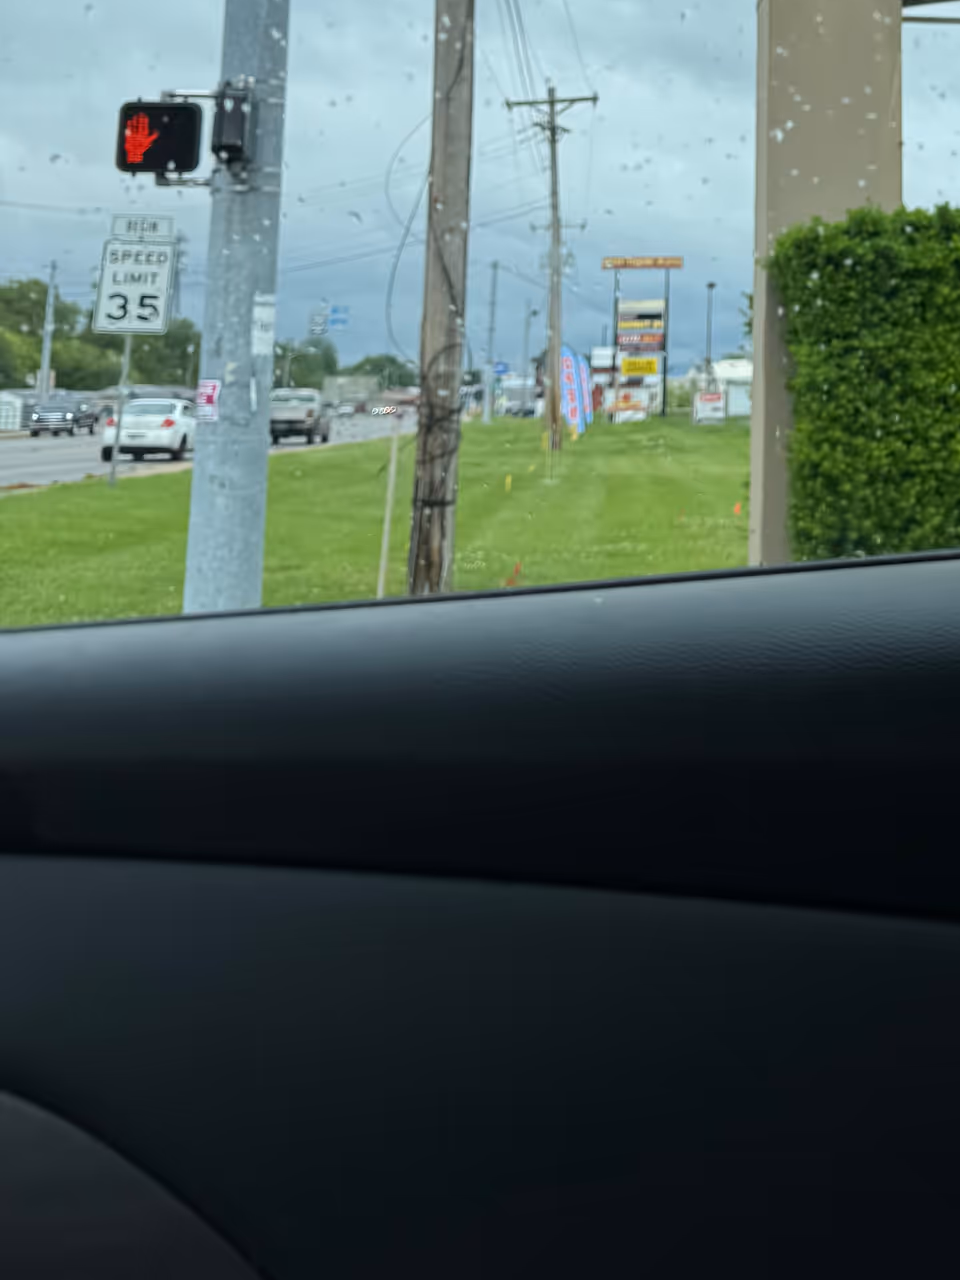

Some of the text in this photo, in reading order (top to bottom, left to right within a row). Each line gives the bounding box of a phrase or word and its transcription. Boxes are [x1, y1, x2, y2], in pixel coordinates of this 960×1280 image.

[109, 250, 168, 264] SPEED
[112, 271, 158, 285] LIMIT
[105, 292, 160, 321] 35
